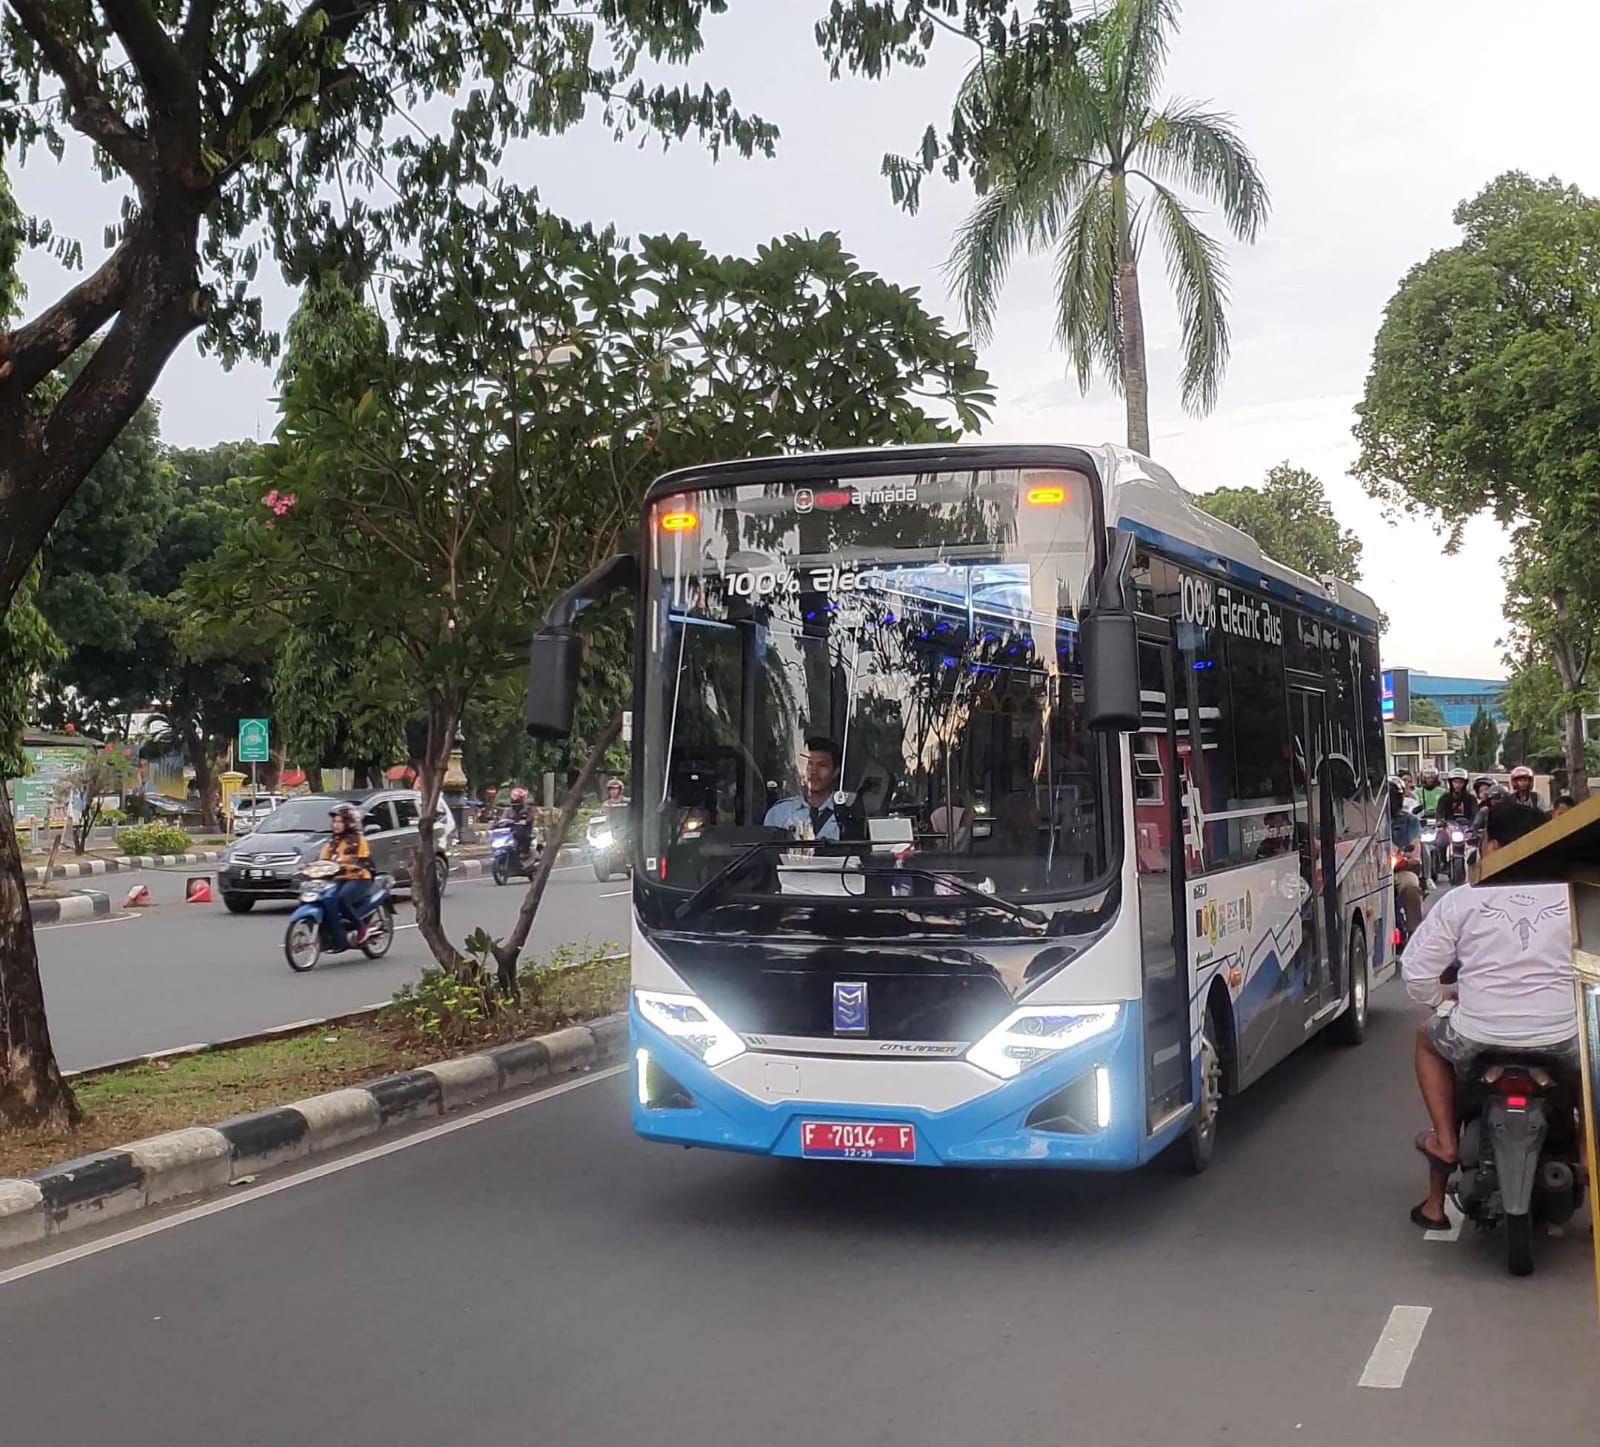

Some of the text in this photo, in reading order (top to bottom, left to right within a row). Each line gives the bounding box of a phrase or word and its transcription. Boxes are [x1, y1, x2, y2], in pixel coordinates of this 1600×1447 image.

[852, 482, 917, 505] armada
[725, 567, 800, 597] 100%
[1178, 573, 1282, 646] 100% Electric Bus
[879, 1043, 957, 1054] CITYLANDER
[805, 1124, 910, 1149] F 7014 F
